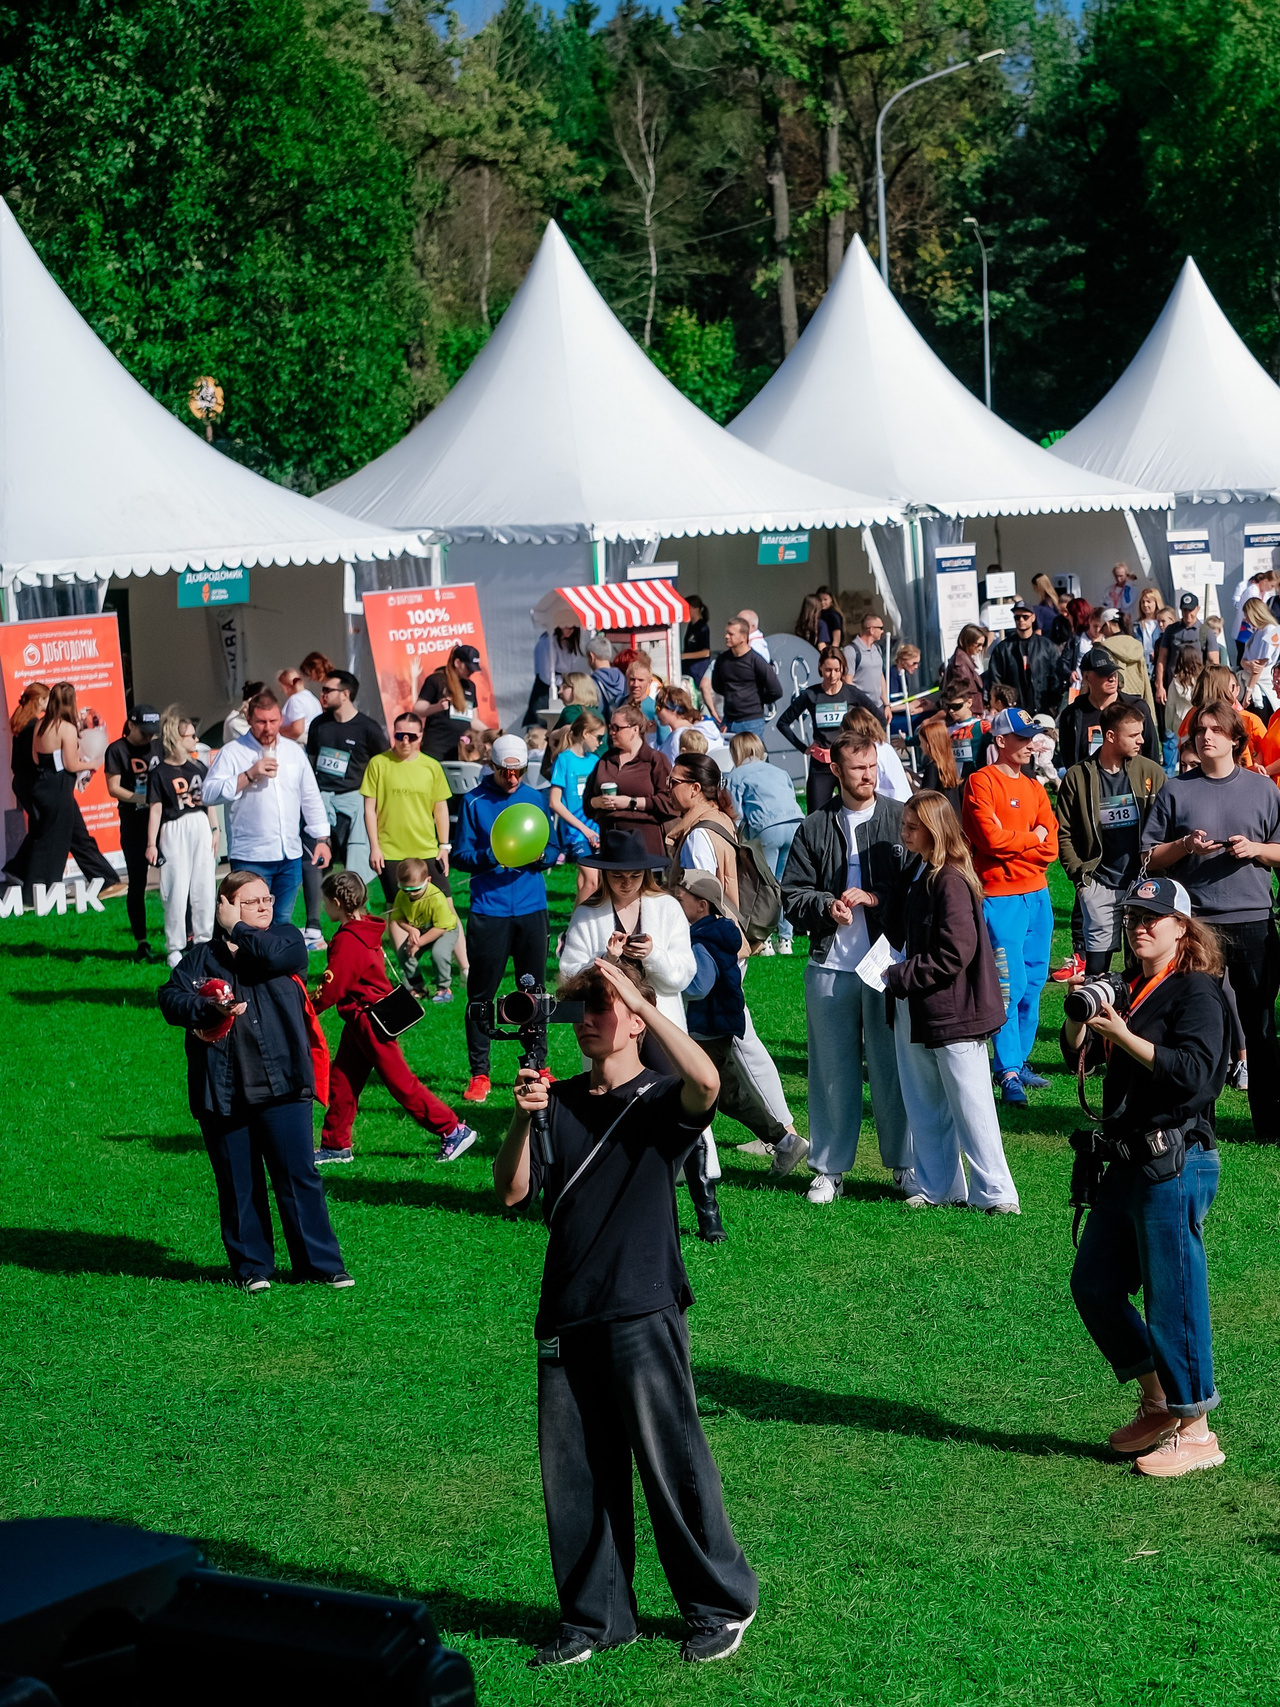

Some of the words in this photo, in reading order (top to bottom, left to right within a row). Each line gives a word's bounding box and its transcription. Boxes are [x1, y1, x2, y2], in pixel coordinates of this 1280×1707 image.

[185, 569, 243, 584] ДОБРОДОМИК
[406, 607, 450, 625] 100%
[389, 622, 475, 641] ПОГРУЖЕНИЕ
[41, 638, 99, 665] ДОБРОДОМИК
[405, 642, 415, 655] В
[417, 638, 463, 655] ДОБРО
[1108, 809, 1130, 821] 318
